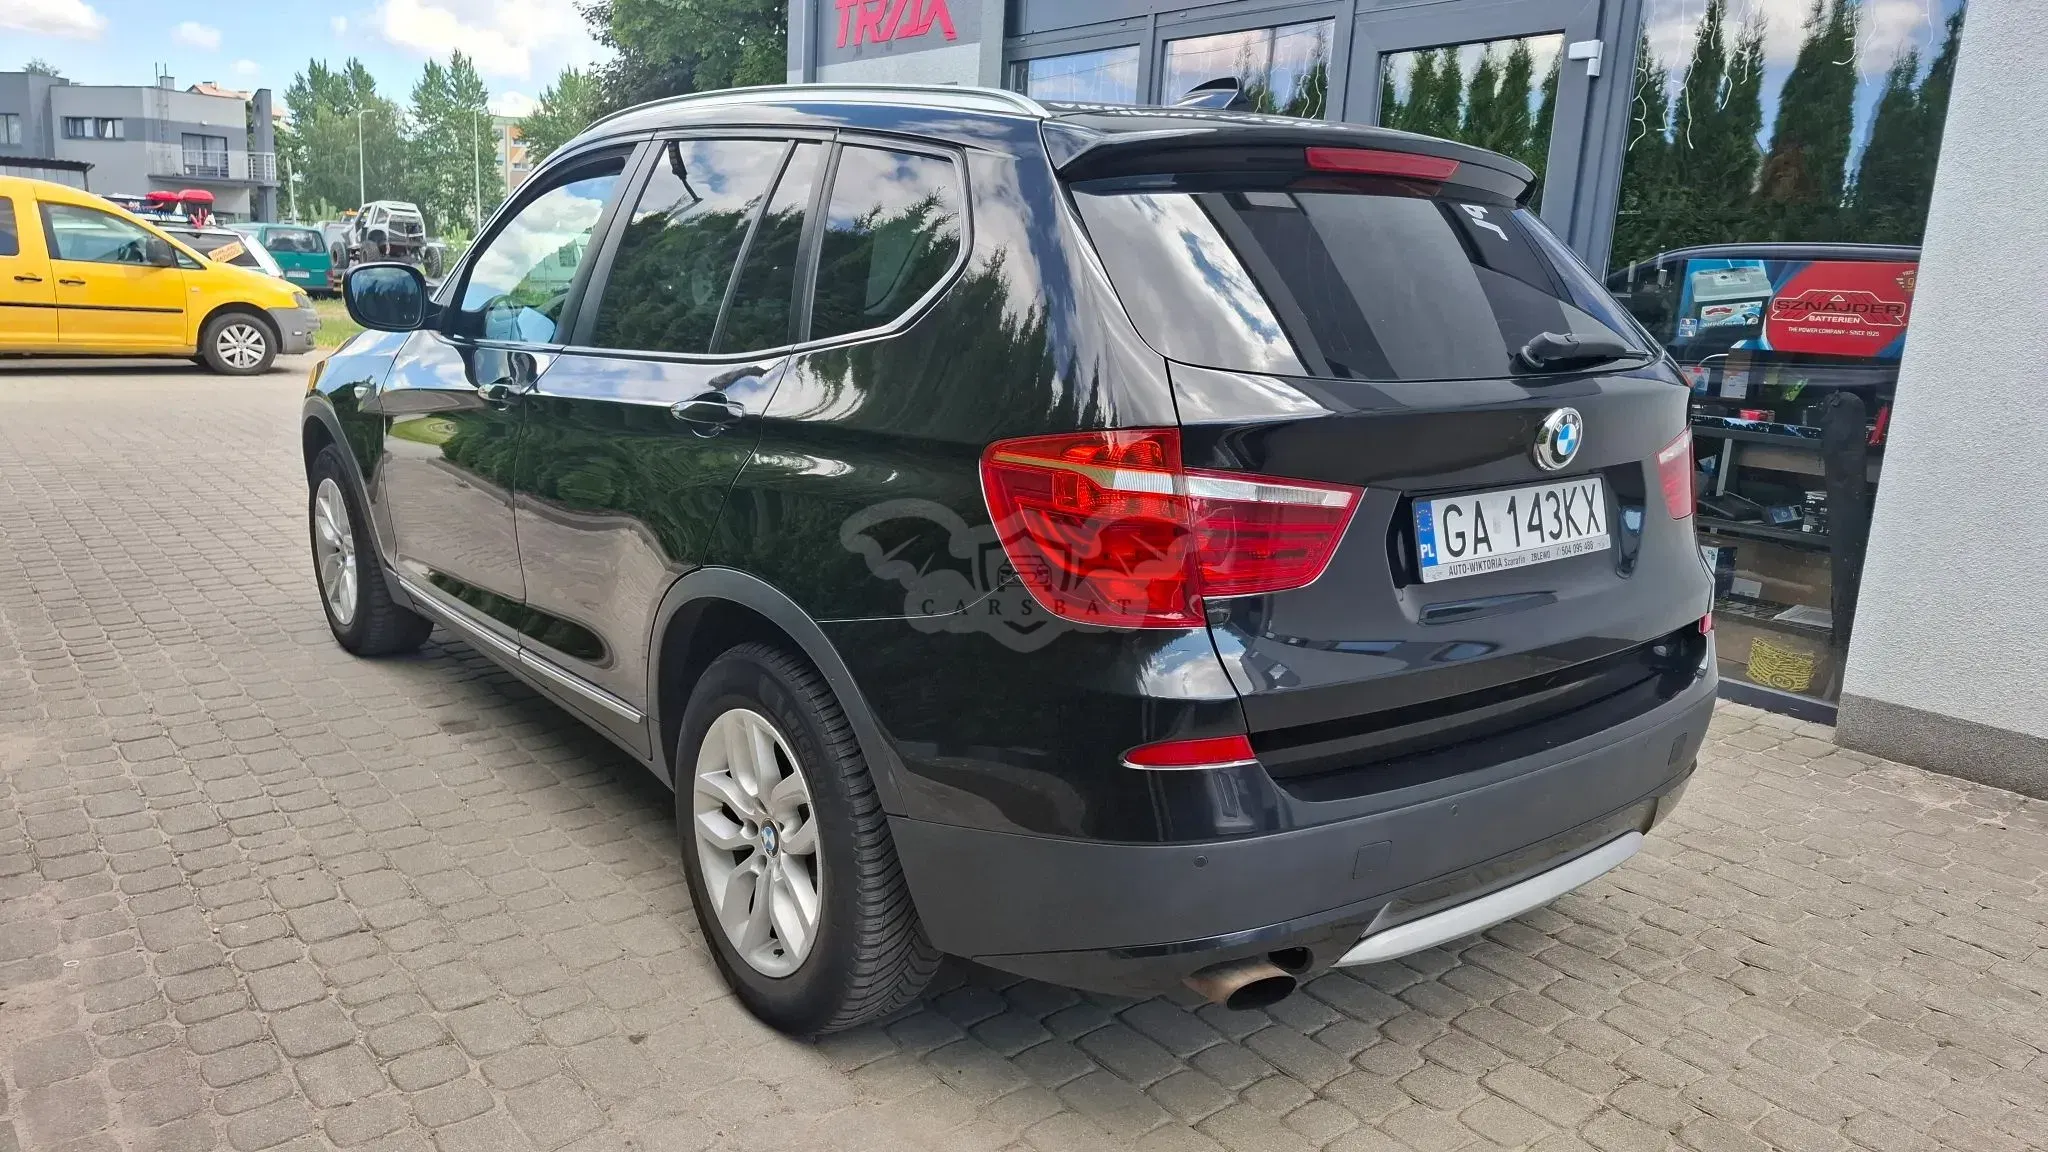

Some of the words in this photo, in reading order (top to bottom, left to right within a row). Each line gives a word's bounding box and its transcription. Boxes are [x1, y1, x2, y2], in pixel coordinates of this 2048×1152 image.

[1775, 300, 1900, 314] SZNAJDER
[1808, 315, 1860, 324] BATTERIEN
[1443, 500, 1493, 558] GA
[1507, 484, 1601, 548] 143KX
[1420, 544, 1435, 559] PL
[1449, 558, 1503, 576] AUTO-WIKTORIA
